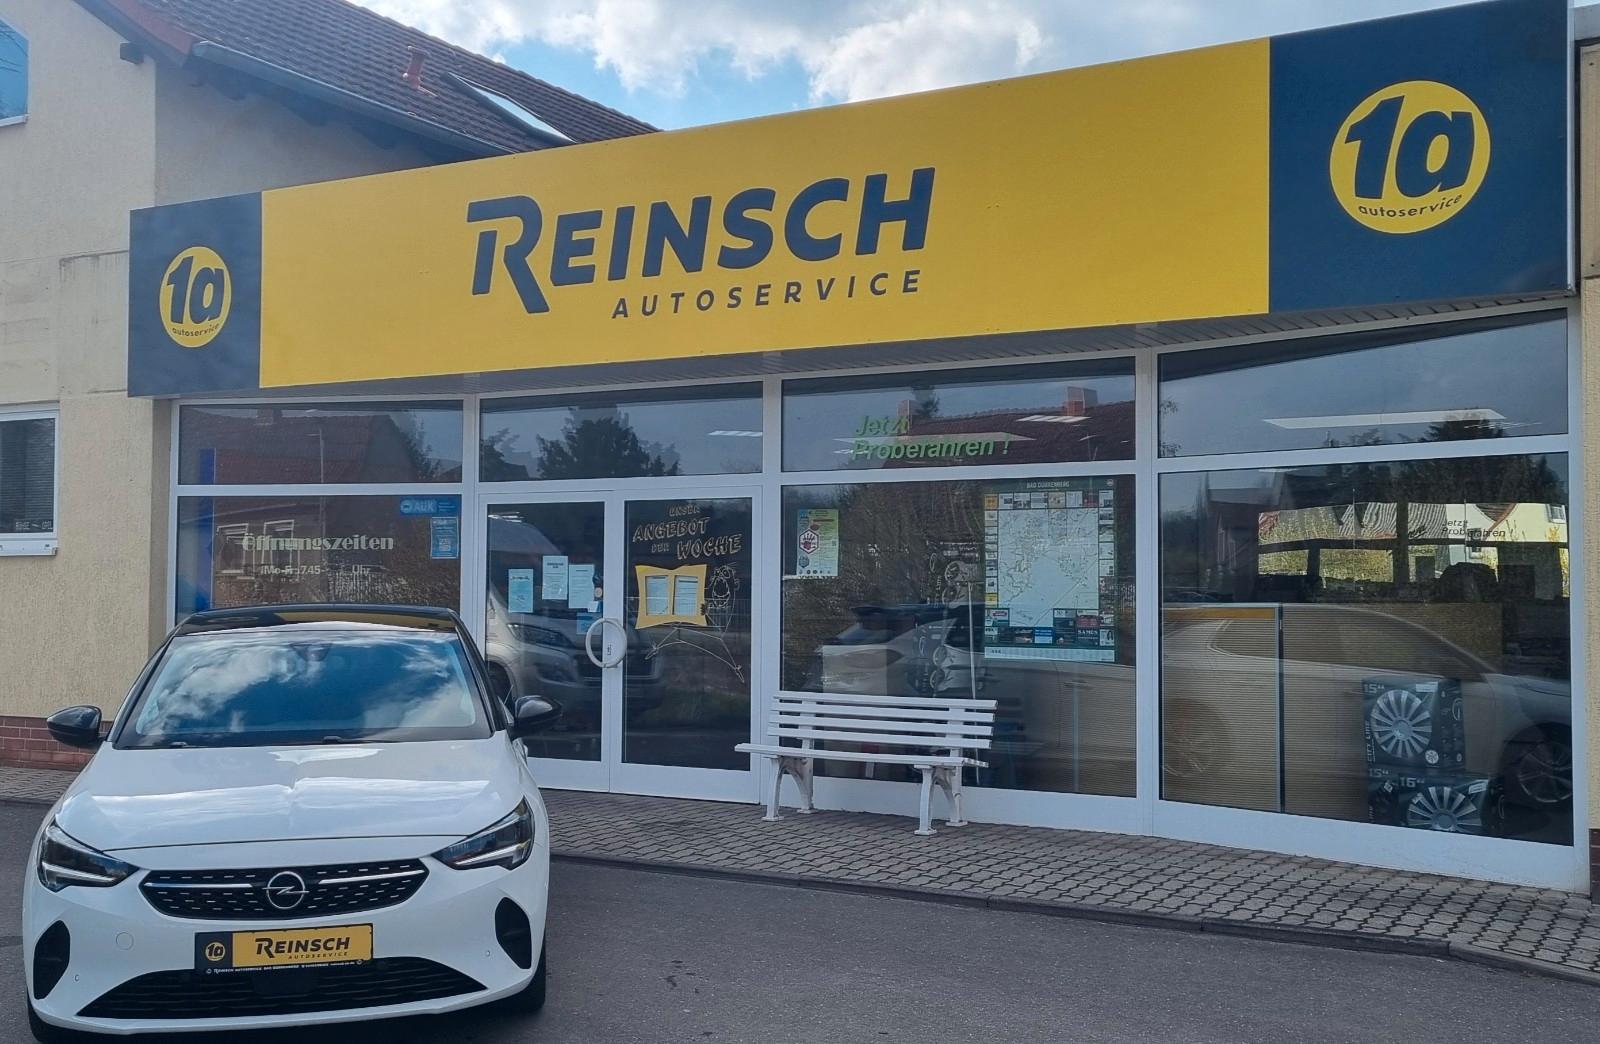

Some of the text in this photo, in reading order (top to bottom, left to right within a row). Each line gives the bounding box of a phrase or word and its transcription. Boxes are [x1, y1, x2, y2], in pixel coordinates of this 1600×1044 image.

[1344, 94, 1475, 200] 1a
[1357, 193, 1463, 218] autoservice
[466, 167, 936, 315] REINSCH
[166, 254, 226, 325] 1a
[611, 269, 921, 319] AUTOSERVICE
[171, 322, 220, 337] autoservice
[855, 415, 909, 436] Jetzt
[241, 532, 394, 551] Öffnungszeiten
[632, 516, 710, 543] ANGEBOT
[676, 533, 742, 560] WOCHE
[255, 936, 351, 959] REINSCH
[287, 950, 348, 960] AUTOSERVICE
